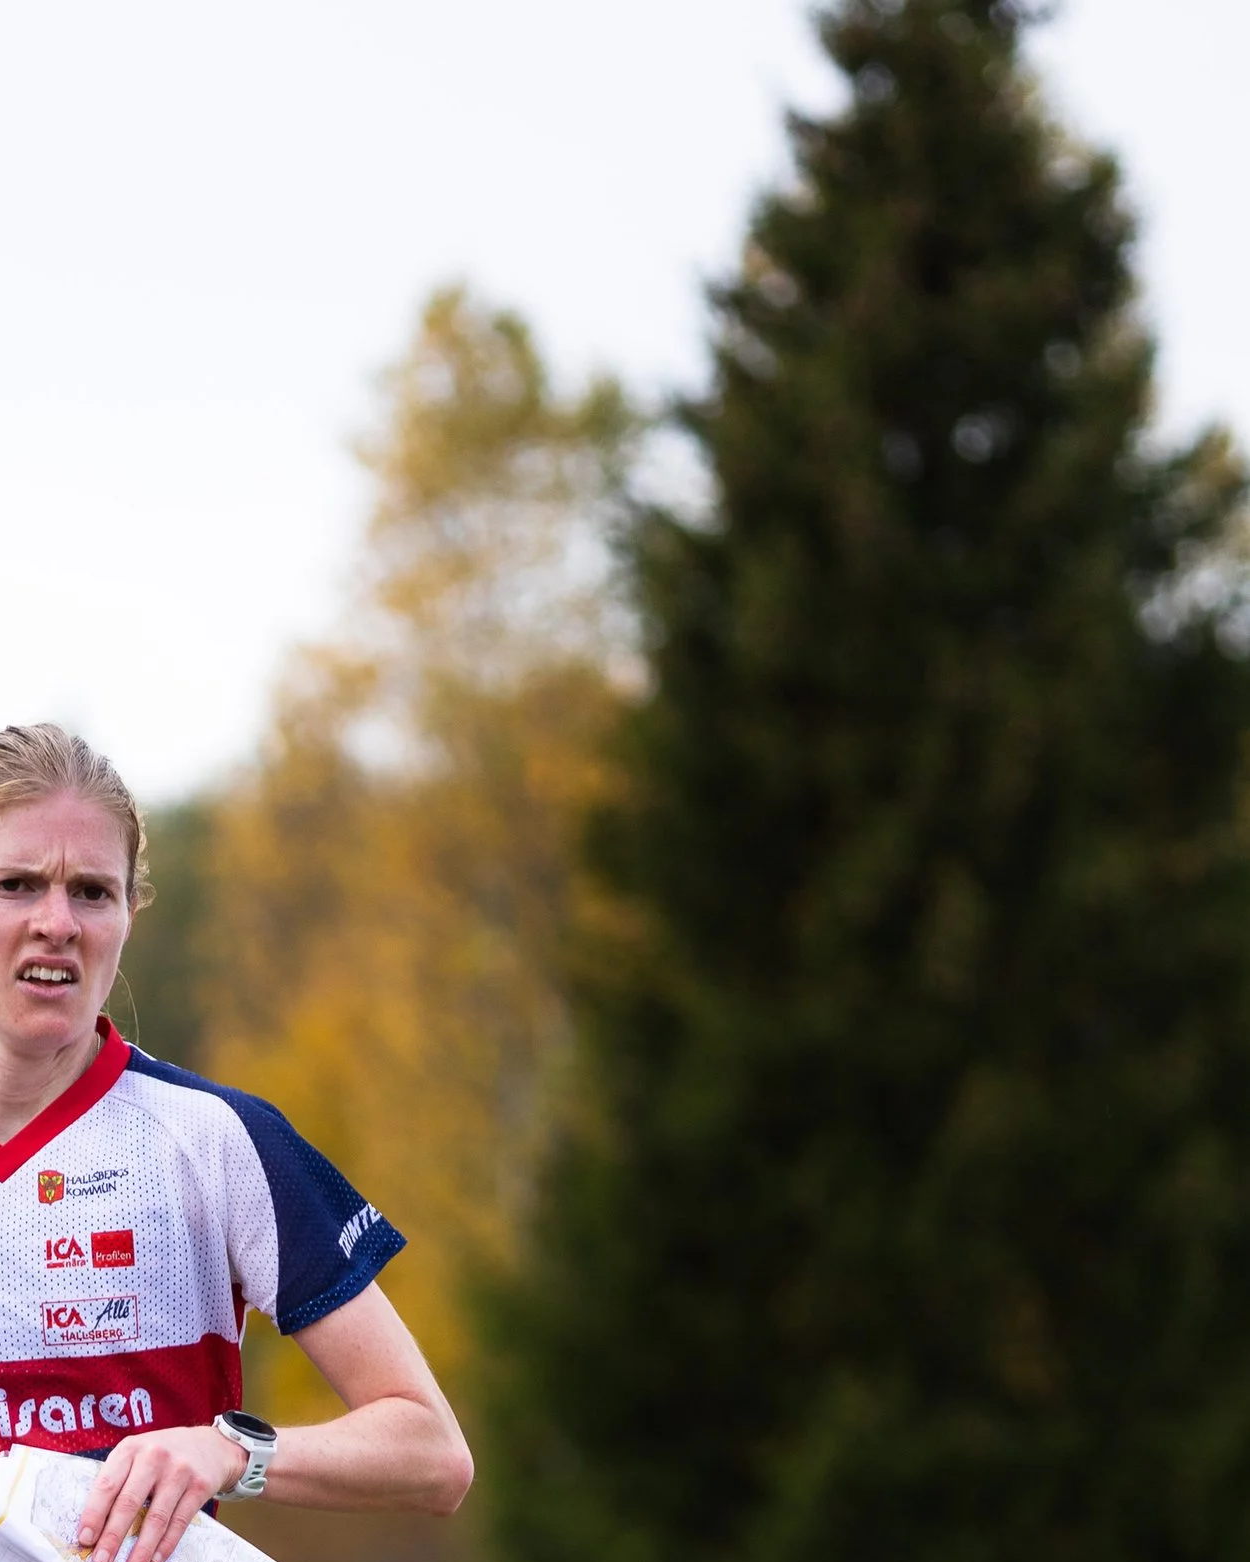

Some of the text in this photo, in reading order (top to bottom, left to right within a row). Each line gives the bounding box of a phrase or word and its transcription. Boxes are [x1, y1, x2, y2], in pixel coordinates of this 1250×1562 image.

[66, 1167, 129, 1185] HALLSBERGS
[66, 1181, 117, 1197] KOMMUN
[46, 1234, 85, 1260] ICA
[65, 1258, 86, 1268] nära
[46, 1299, 131, 1329] ICA Allé
[61, 1328, 124, 1342] HALLSBERG
